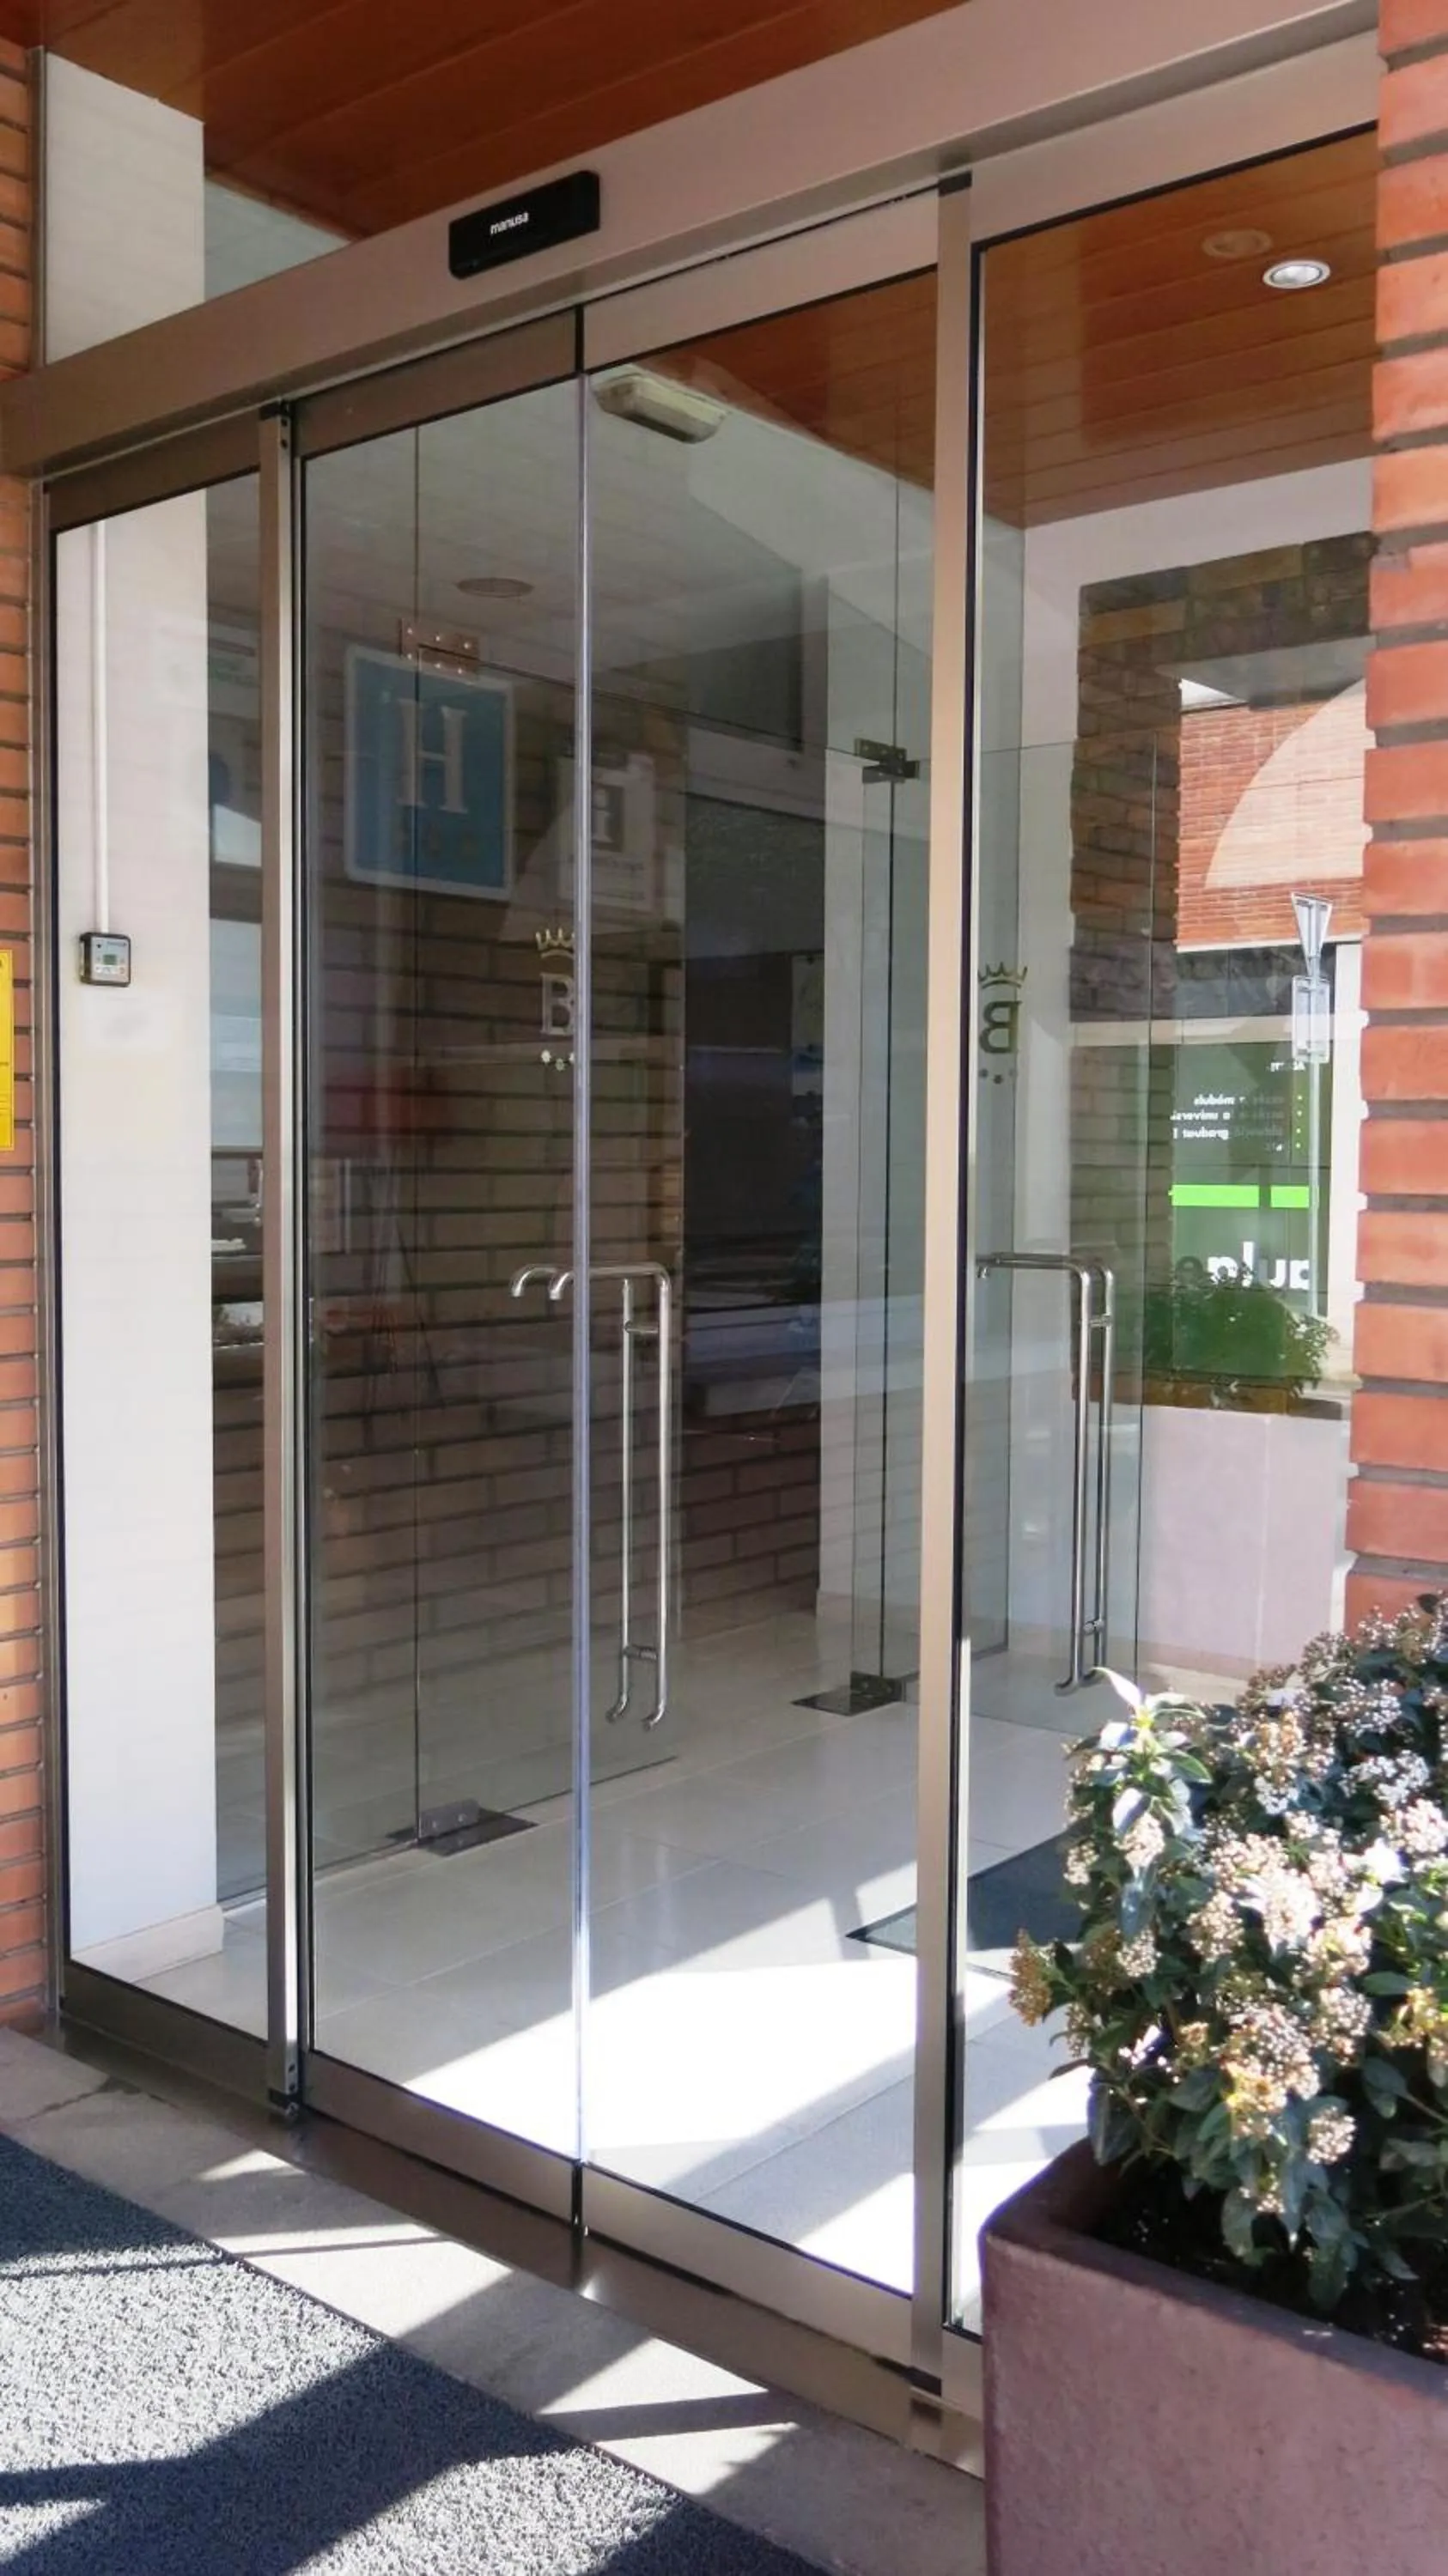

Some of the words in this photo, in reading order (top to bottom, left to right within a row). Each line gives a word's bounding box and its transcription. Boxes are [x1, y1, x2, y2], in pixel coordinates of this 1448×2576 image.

[490, 211, 529, 234] manusa
[396, 698, 469, 814] H
[541, 972, 575, 1036] B
